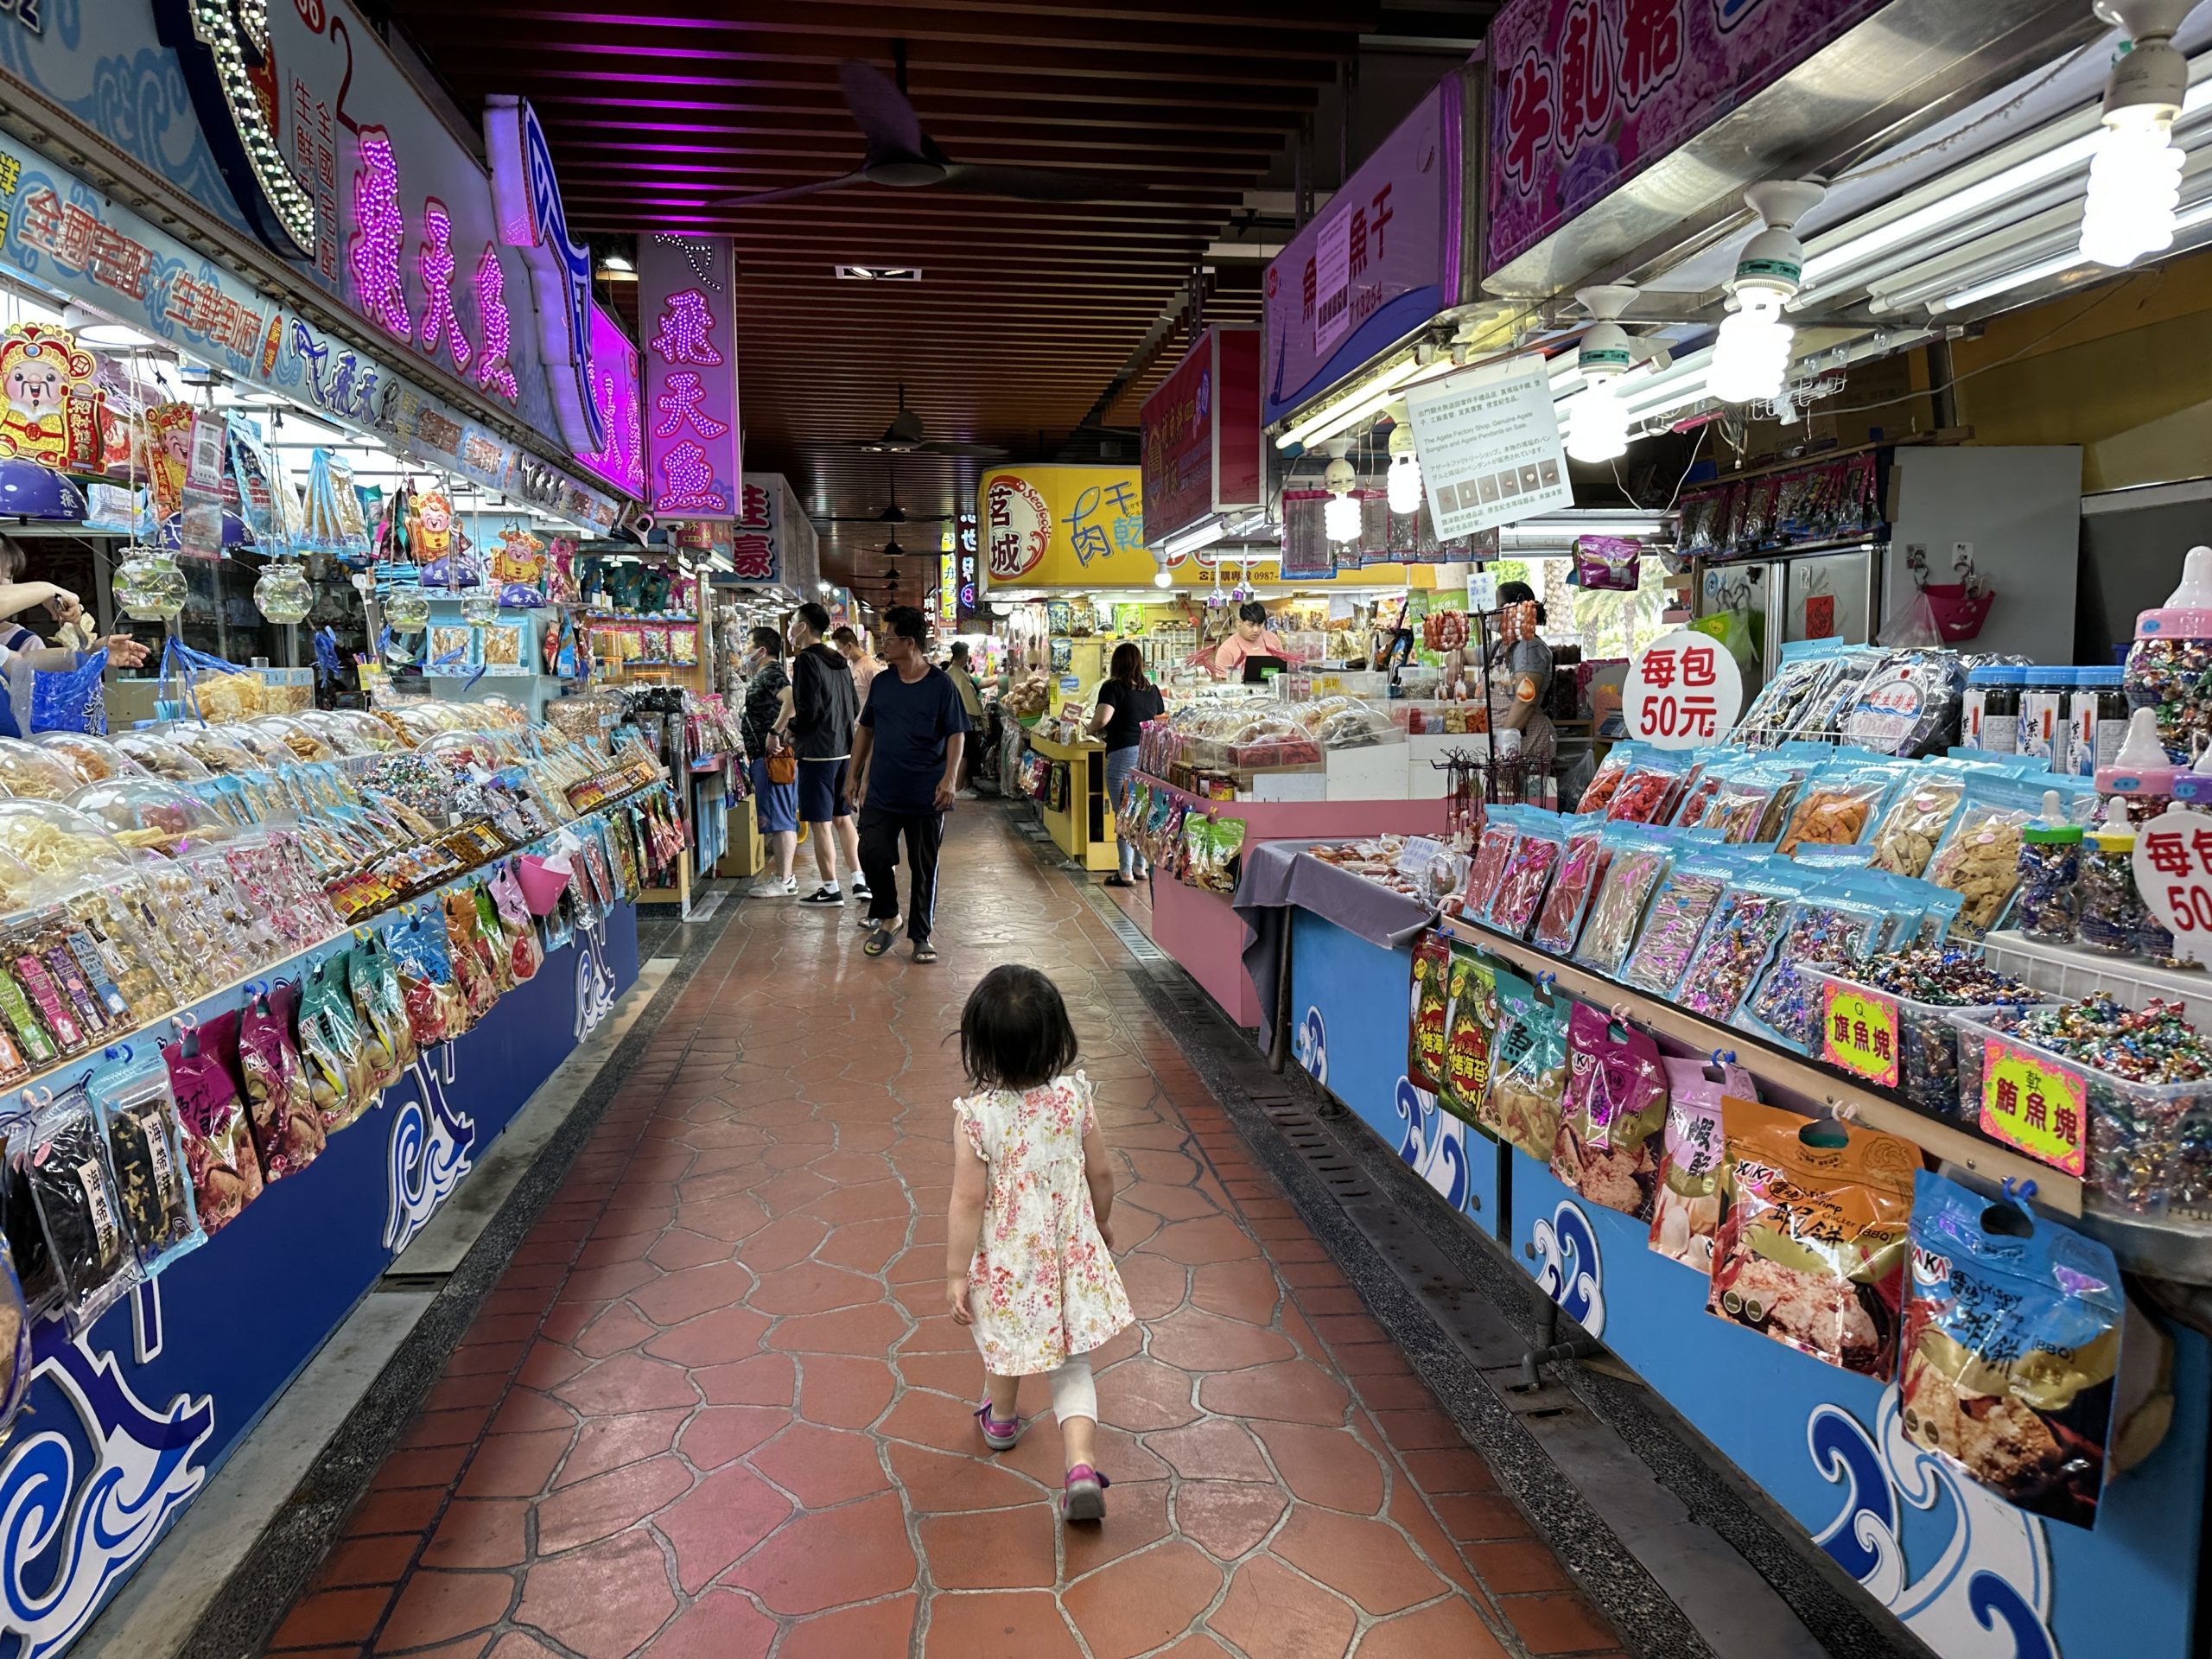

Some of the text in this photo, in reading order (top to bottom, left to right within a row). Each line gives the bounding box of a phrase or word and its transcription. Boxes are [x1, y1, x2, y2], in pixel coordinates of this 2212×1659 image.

[316, 101, 338, 283] 全國宅配
[18, 188, 153, 301] 全國宅配
[351, 127, 518, 404] 飛天魚
[164, 267, 264, 359] 生鮮到府
[651, 288, 728, 512] 飛天魚
[1424, 436, 1435, 445] The
[1453, 427, 1474, 438] Factory
[1449, 439, 1460, 448] and
[1022, 487, 1052, 539] Seafood
[1640, 645, 1716, 689] 每包
[1640, 696, 1717, 737] 50元
[1853, 1001, 1865, 1015] Q
[1834, 1014, 1891, 1063] 旗魚塊
[1451, 1055, 1487, 1084] 烤海苔
[1995, 1076, 2077, 1147] 鮪魚塊
[1912, 1247, 1948, 1281] AKA
